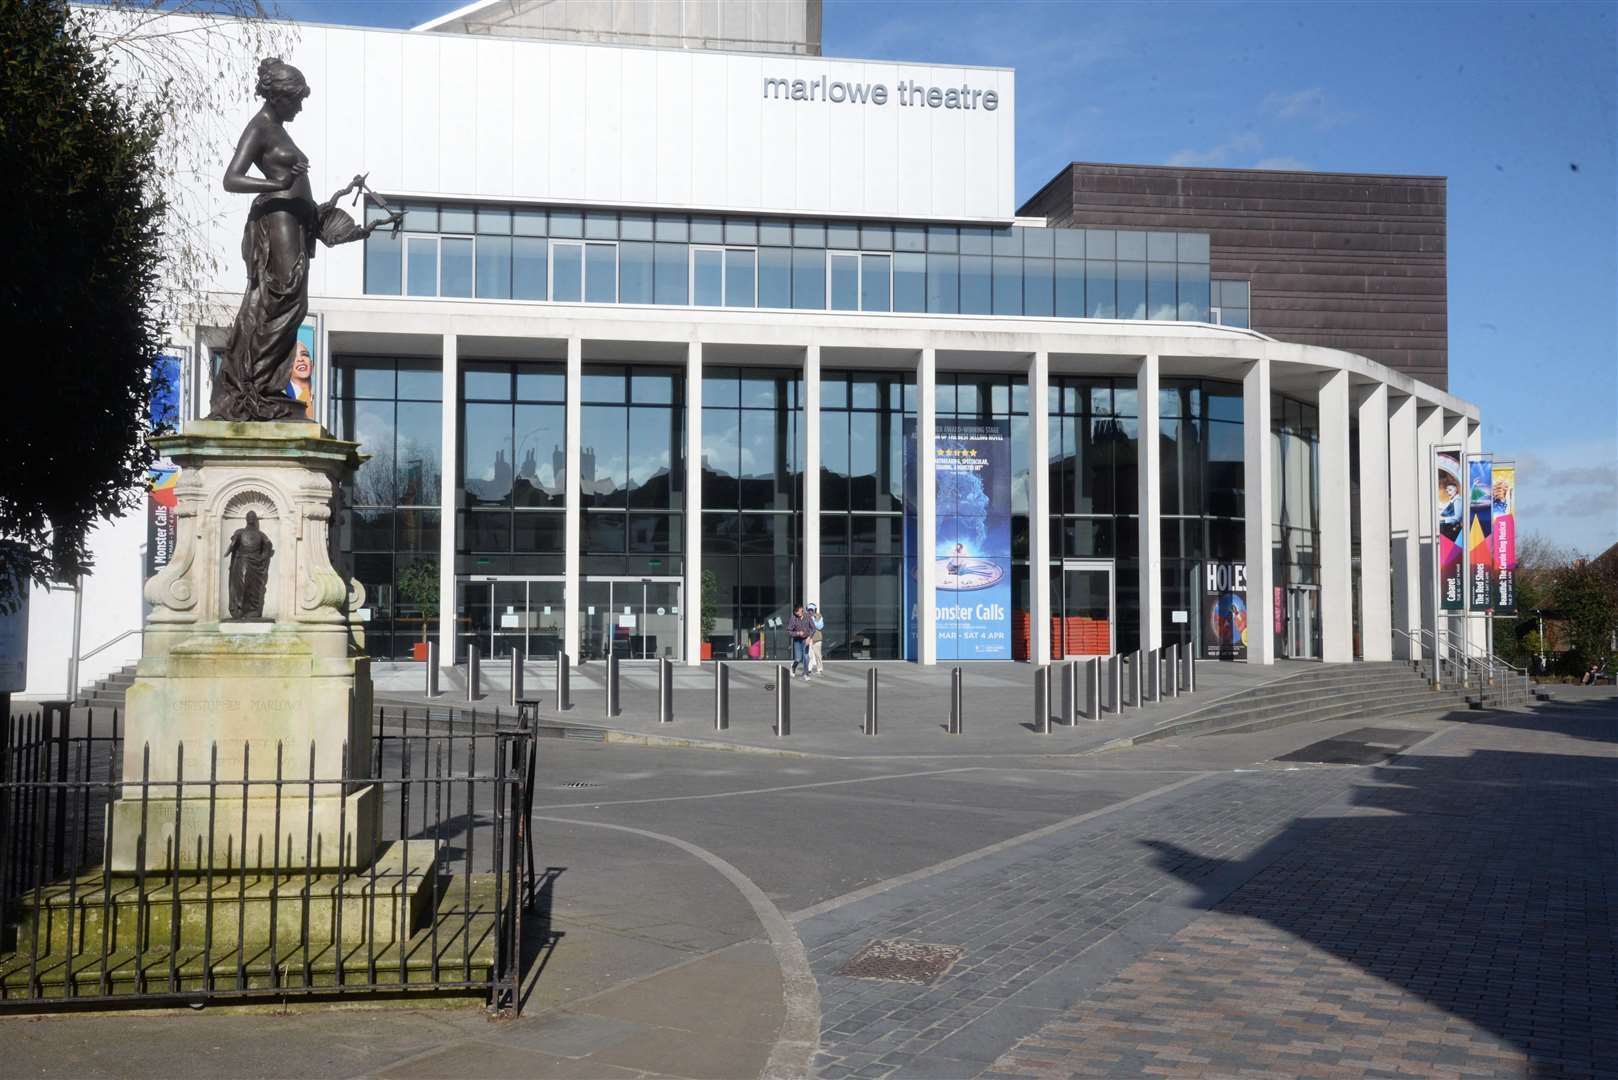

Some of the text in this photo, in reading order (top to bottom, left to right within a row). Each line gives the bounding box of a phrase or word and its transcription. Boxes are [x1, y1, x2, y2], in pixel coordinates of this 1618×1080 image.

[763, 75, 999, 111] marlowe theatre
[155, 506, 167, 526] Calls
[154, 528, 167, 563] Monster
[1447, 578, 1456, 601] Cabaret
[1476, 563, 1484, 604] The Red Shoes
[936, 604, 973, 621] onster
[976, 604, 1005, 621] Calls
[938, 632, 957, 640] MAR
[963, 632, 979, 640] SAT
[988, 632, 1005, 640] APR
